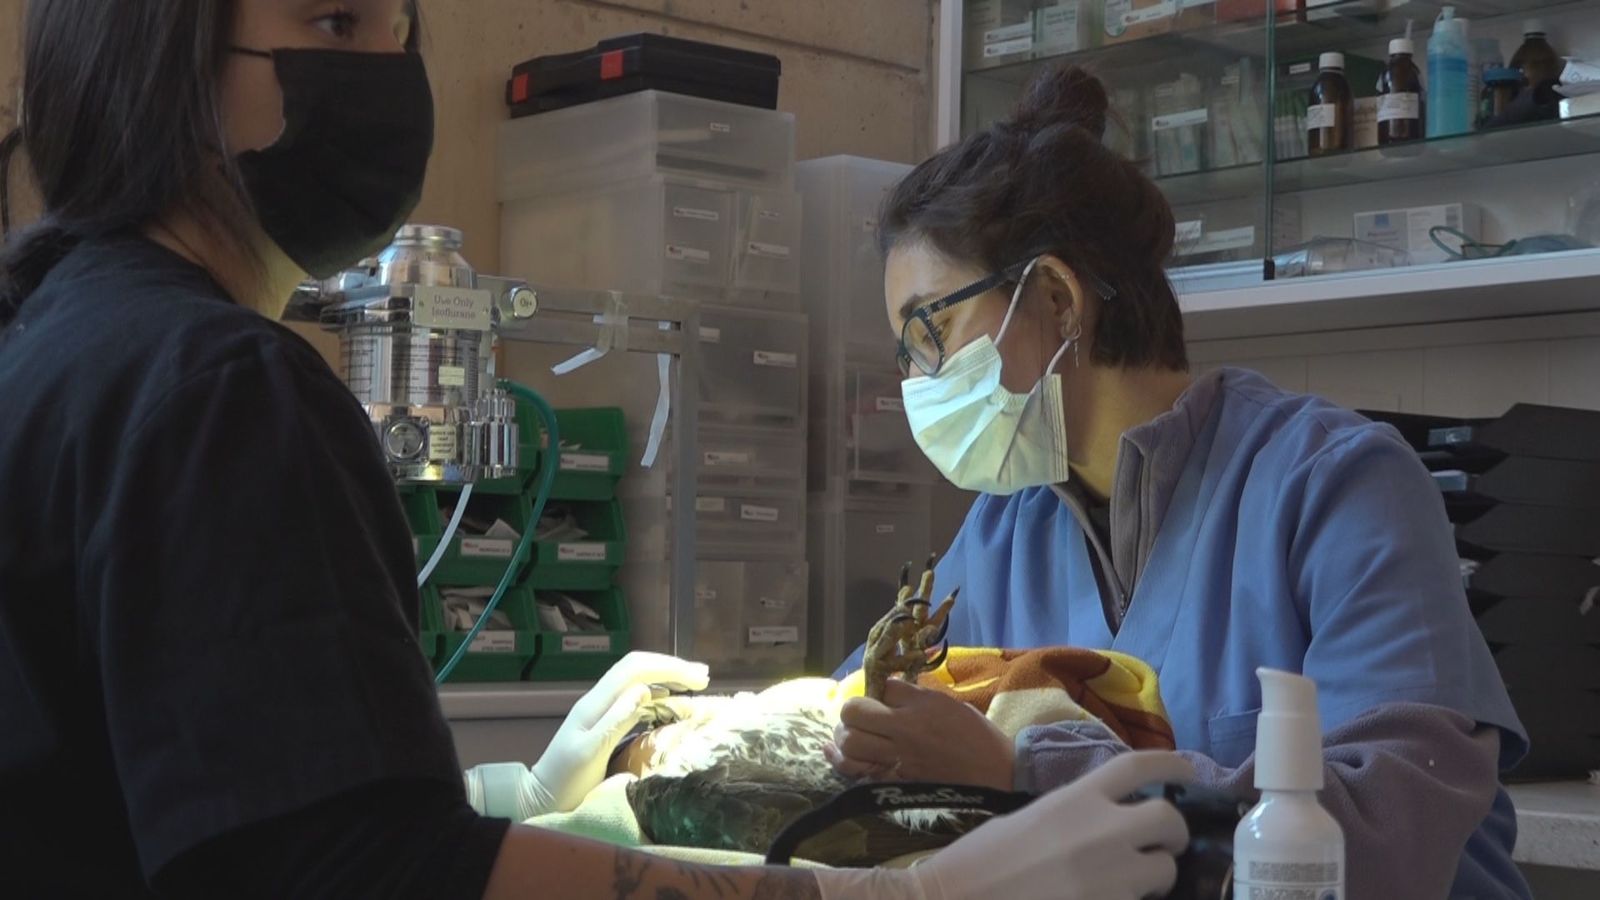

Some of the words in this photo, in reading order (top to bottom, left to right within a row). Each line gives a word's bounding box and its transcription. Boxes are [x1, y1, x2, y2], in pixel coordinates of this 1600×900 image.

[434, 295, 451, 305] Use
[453, 296, 474, 309] Only
[431, 305, 477, 320] Isoflurane
